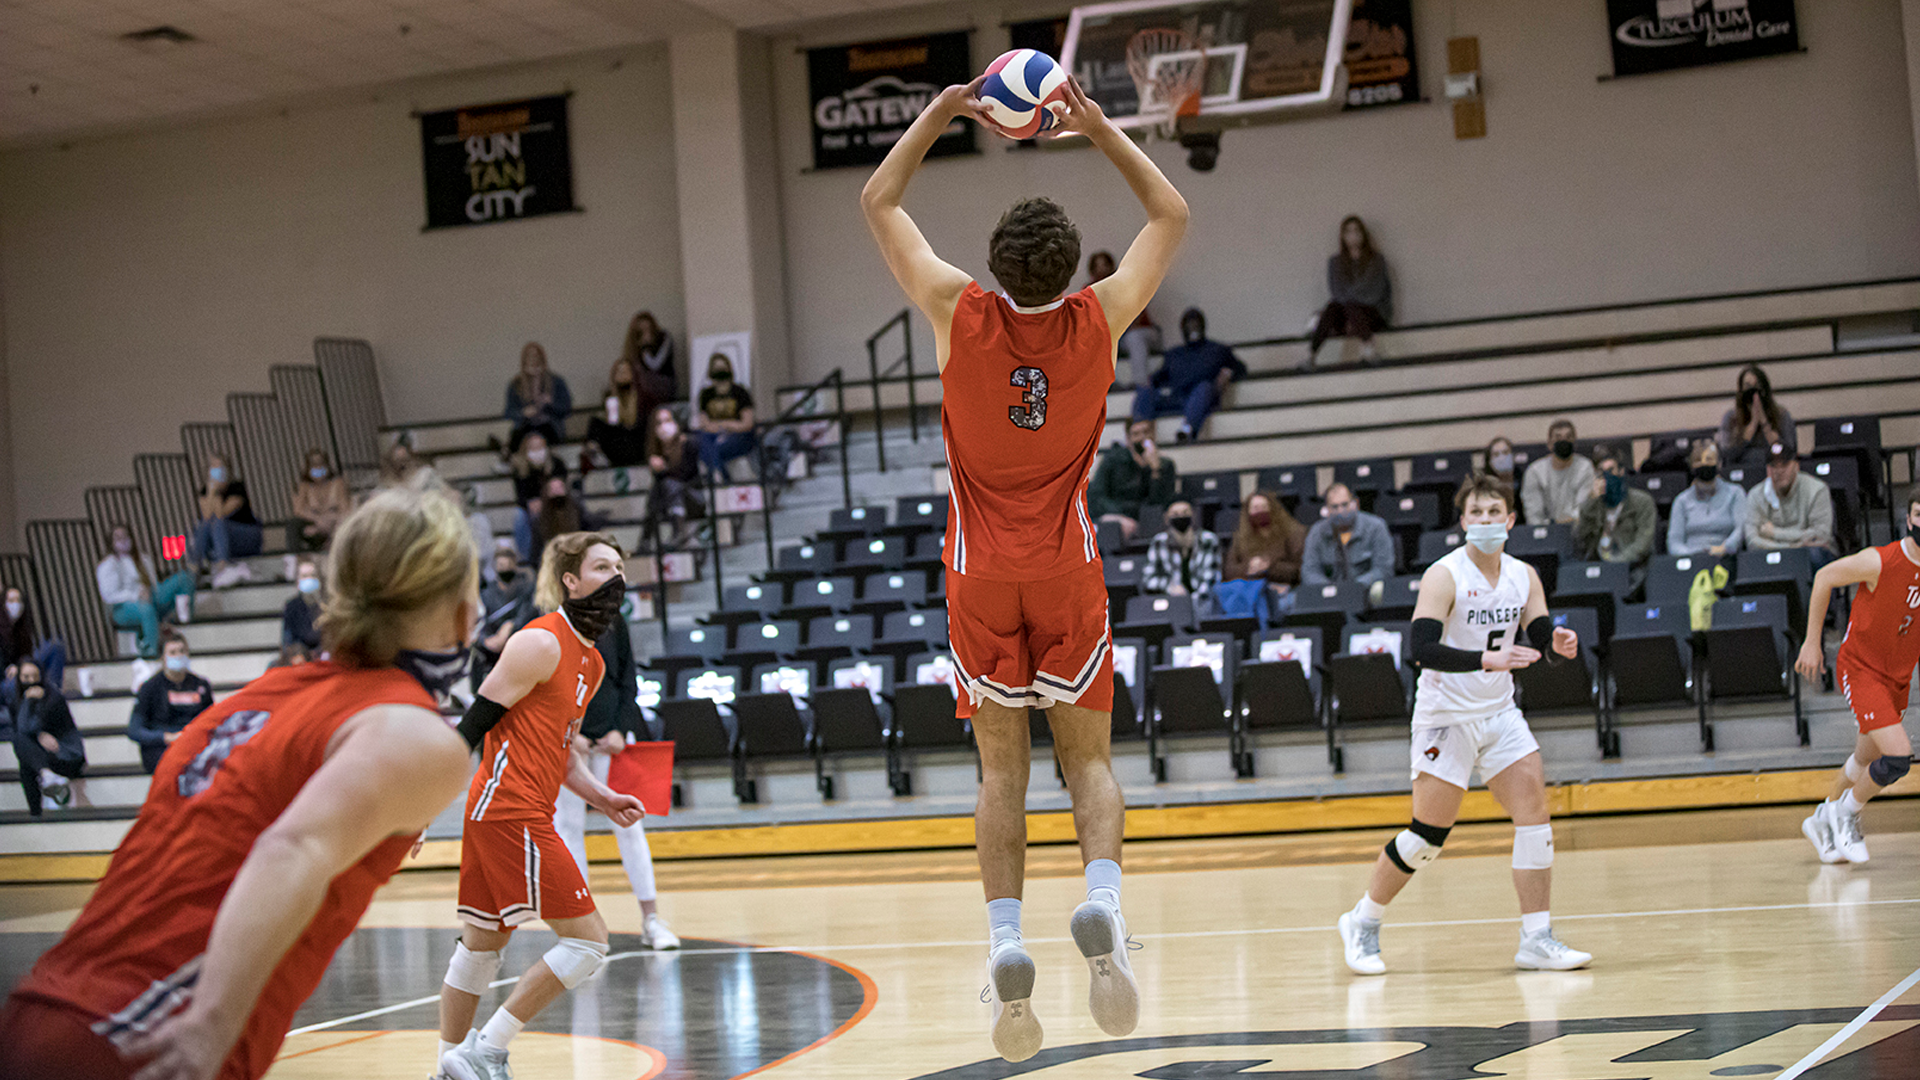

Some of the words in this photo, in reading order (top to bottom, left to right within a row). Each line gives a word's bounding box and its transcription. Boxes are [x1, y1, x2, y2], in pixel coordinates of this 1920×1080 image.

[815, 96, 929, 130] GATEW
[464, 131, 522, 169] SUN
[469, 160, 526, 190] TAN
[465, 186, 536, 222] CITY
[1009, 366, 1049, 432] 3
